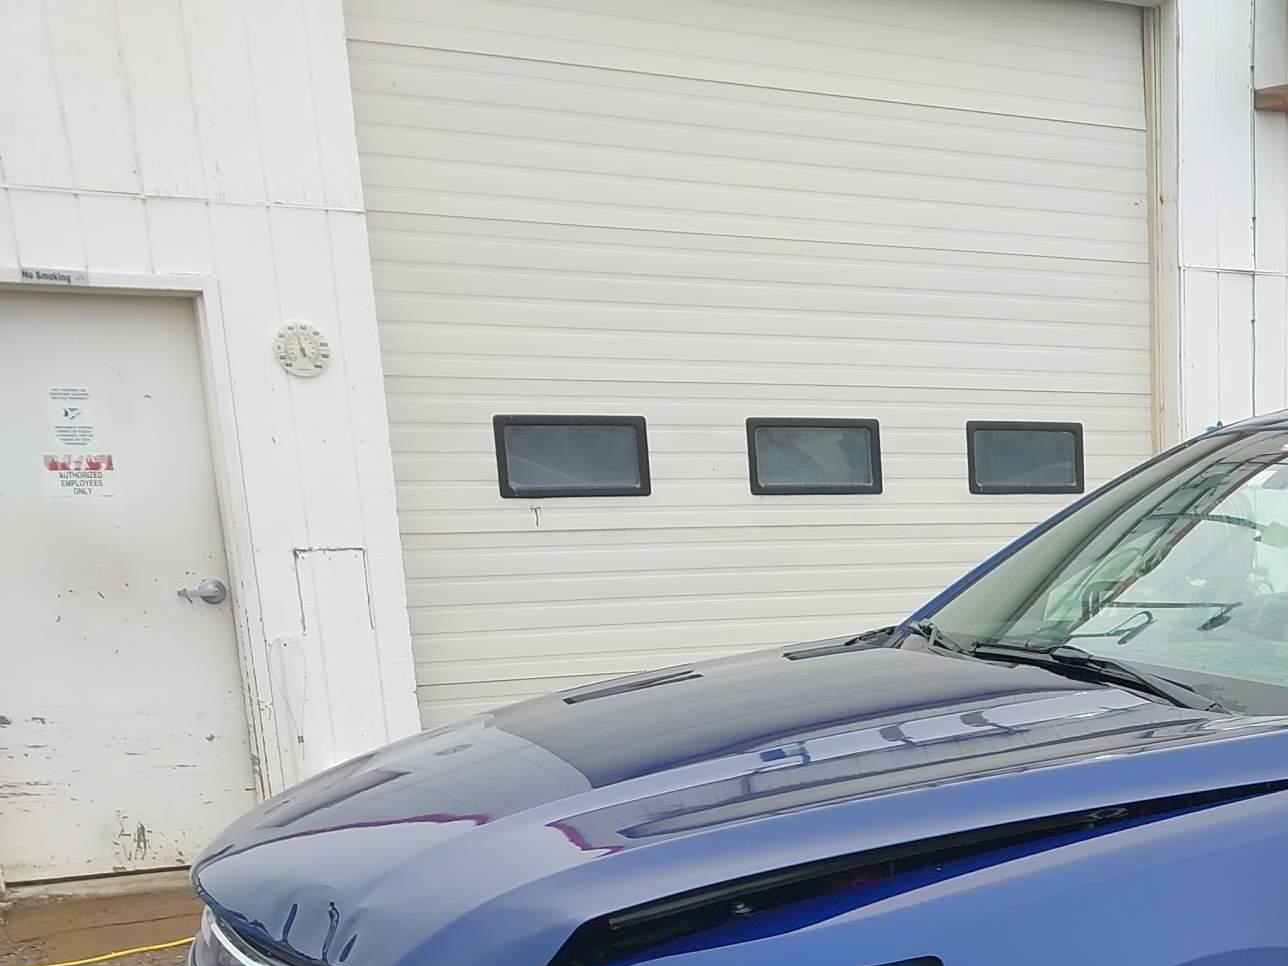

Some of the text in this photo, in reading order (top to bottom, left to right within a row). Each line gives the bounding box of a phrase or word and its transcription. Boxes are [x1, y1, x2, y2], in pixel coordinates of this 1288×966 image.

[22, 269, 71, 284] No Smoking
[59, 471, 103, 479] AUTHORIZED
[73, 487, 92, 495] ONLY
